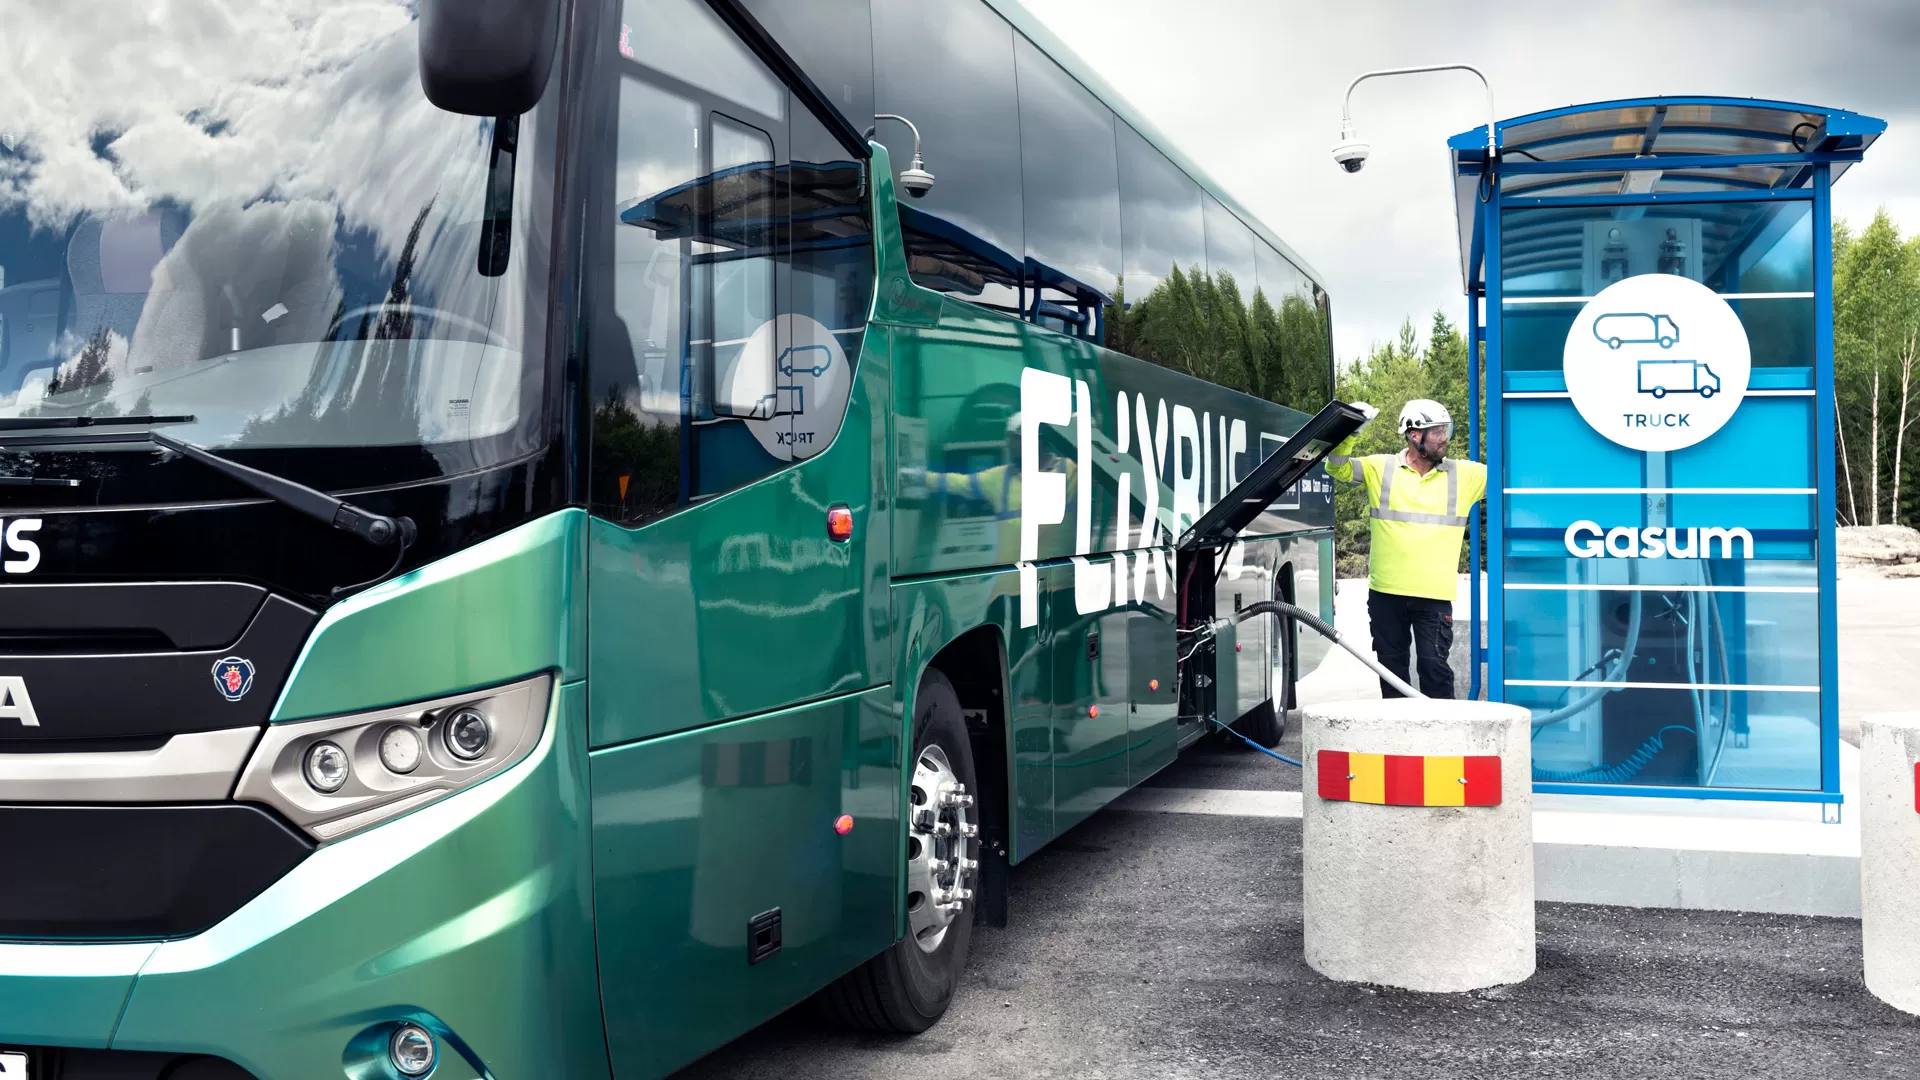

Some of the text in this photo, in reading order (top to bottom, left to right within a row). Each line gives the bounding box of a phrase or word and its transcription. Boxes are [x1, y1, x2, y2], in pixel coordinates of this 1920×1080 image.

[1623, 413, 1690, 427] TRUCK
[0, 518, 42, 573] S
[1564, 519, 1754, 559] Gasum
